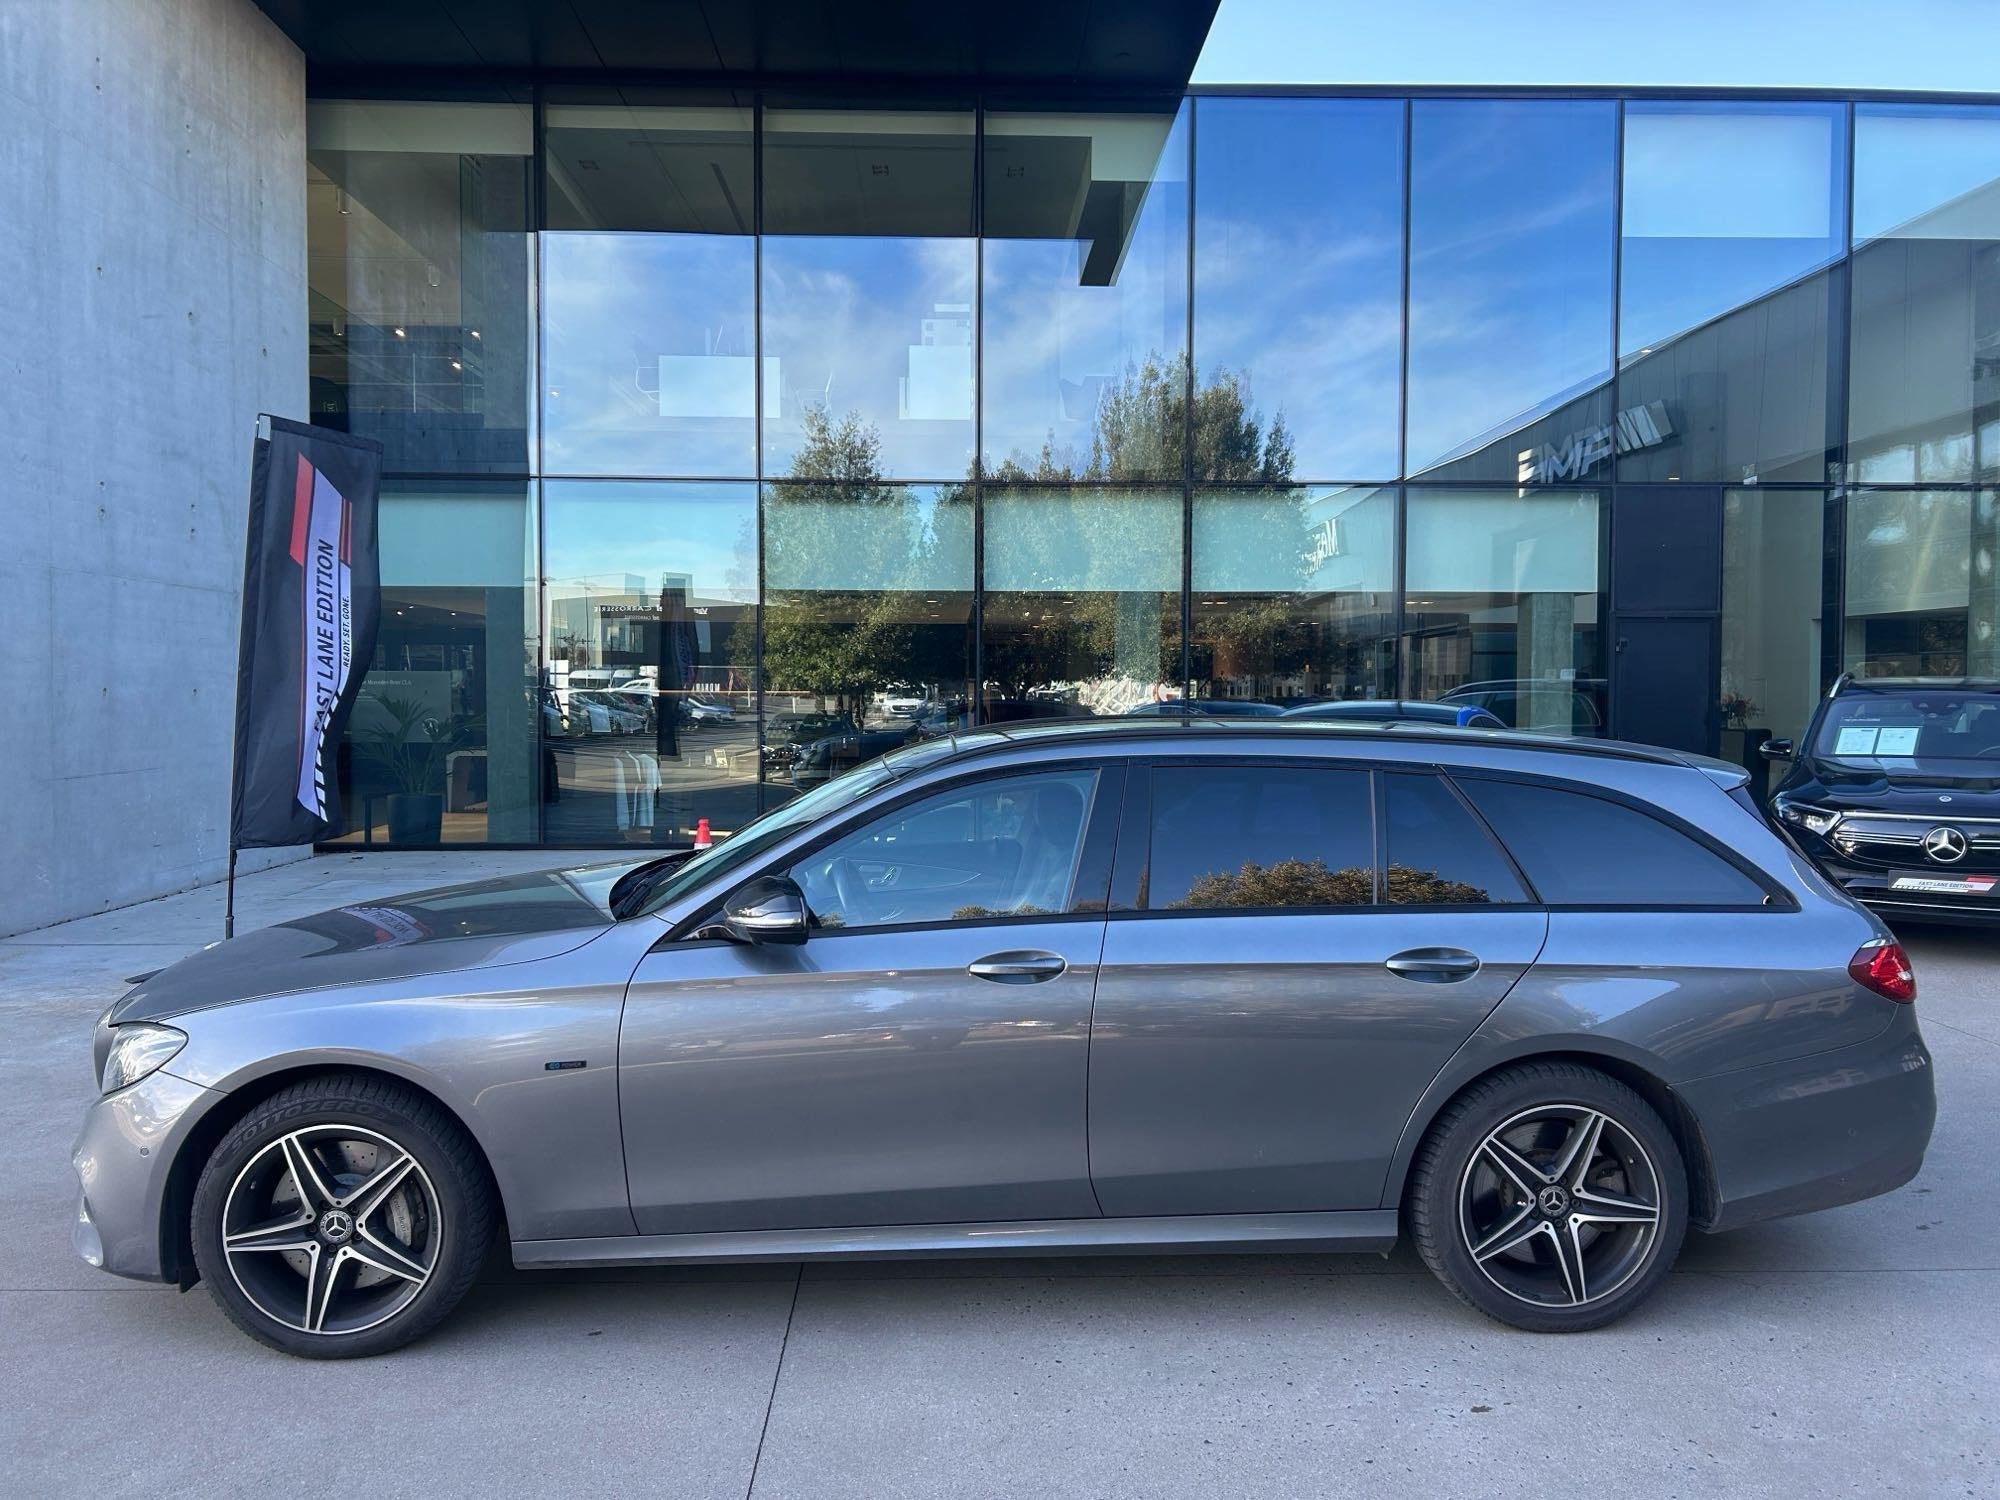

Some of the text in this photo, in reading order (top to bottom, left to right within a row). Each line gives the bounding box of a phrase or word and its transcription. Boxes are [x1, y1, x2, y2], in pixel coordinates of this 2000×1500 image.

[316, 540, 335, 625] EDITION
[316, 626, 334, 681] LANE
[342, 596, 350, 668] READY. SET. GONE.
[232, 1099, 373, 1153] SOTTOZERO
